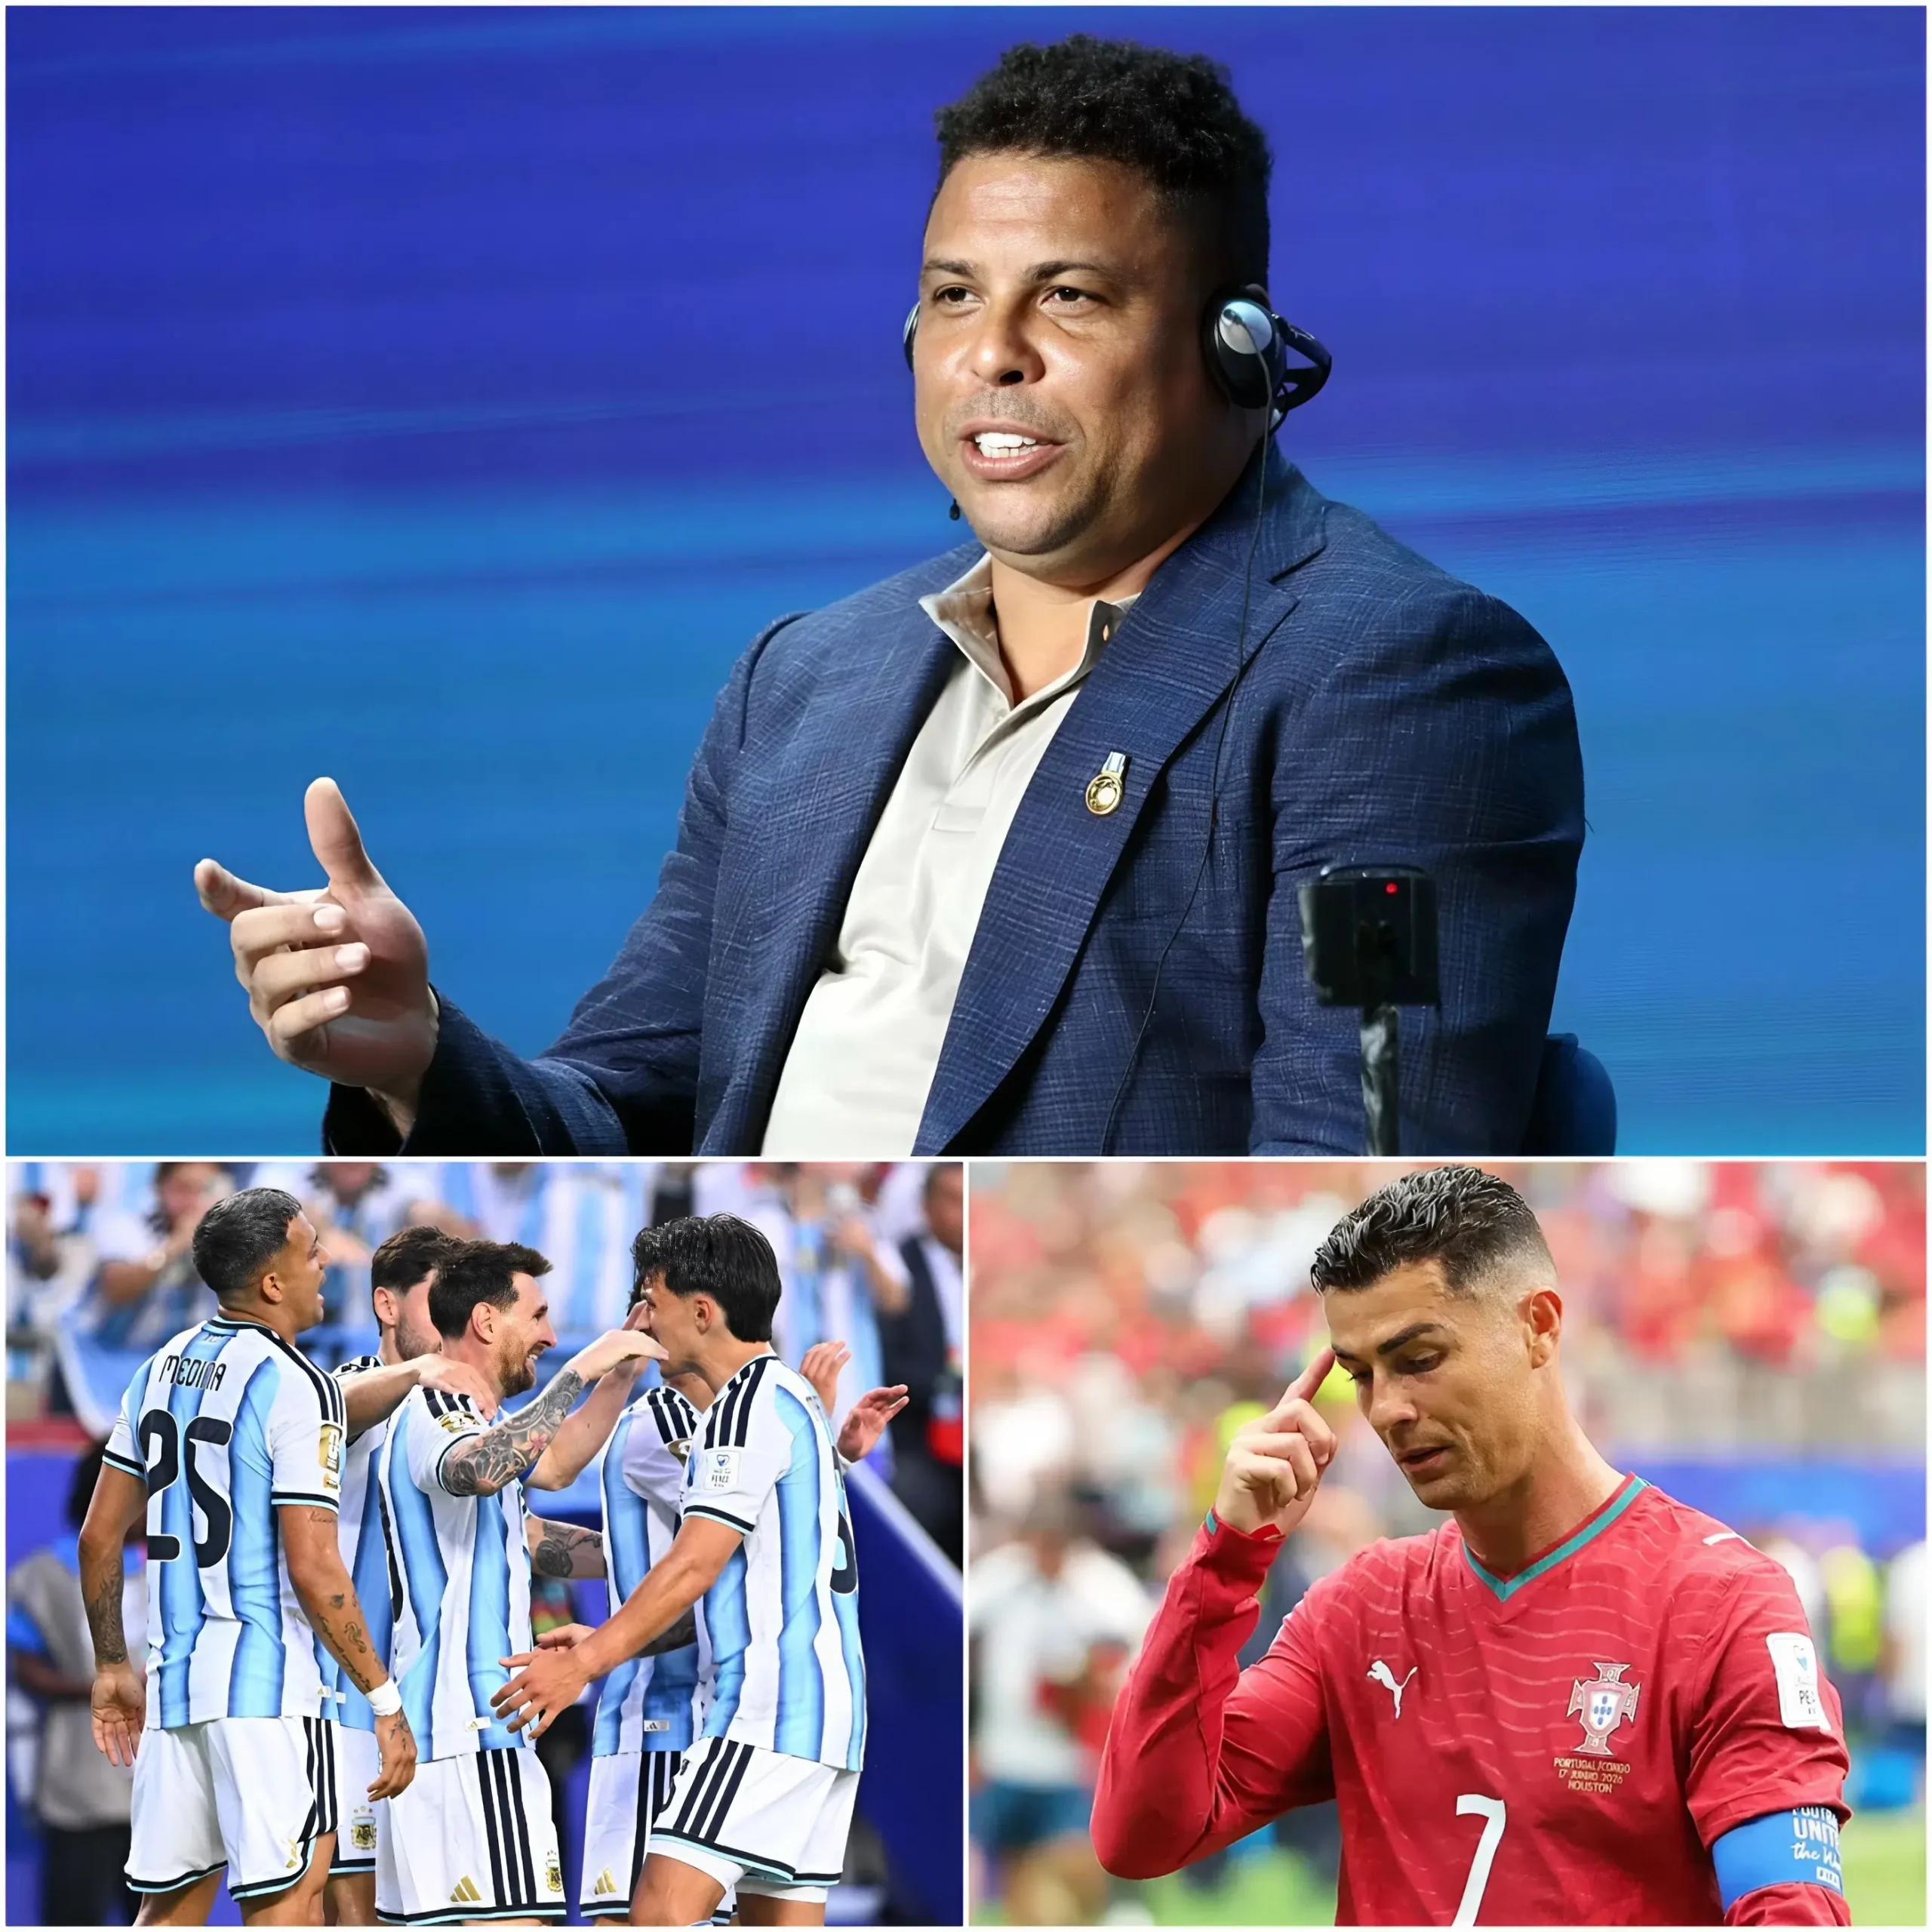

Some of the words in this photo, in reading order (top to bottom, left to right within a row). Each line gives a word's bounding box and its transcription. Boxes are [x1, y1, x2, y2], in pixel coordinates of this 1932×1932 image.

[158, 1355, 226, 1391] MEDINA
[139, 1409, 232, 1568] 25
[1567, 1780, 1613, 1793] HOUSTON
[1451, 1795, 1506, 1926] 7
[1790, 1841, 1820, 1860] the
